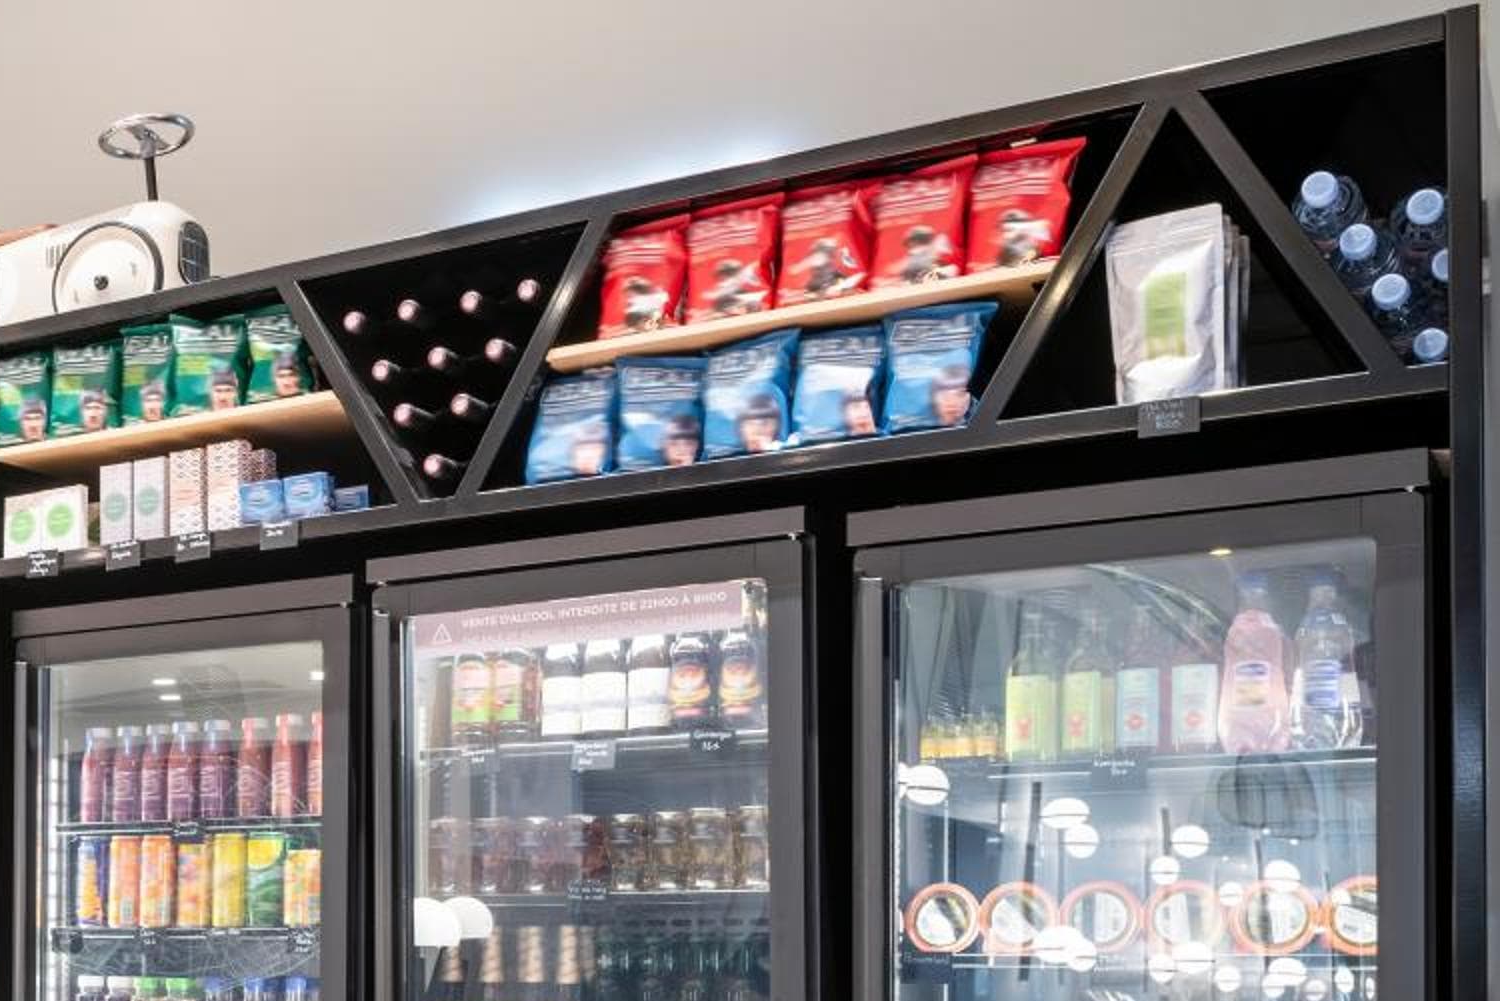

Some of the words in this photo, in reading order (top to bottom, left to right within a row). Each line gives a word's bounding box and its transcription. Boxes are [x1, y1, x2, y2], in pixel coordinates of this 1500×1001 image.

[462, 615, 498, 628] VENTE
[499, 611, 555, 625] D'ALCOOL
[559, 603, 618, 617] INTERDITE
[620, 600, 637, 612] DE
